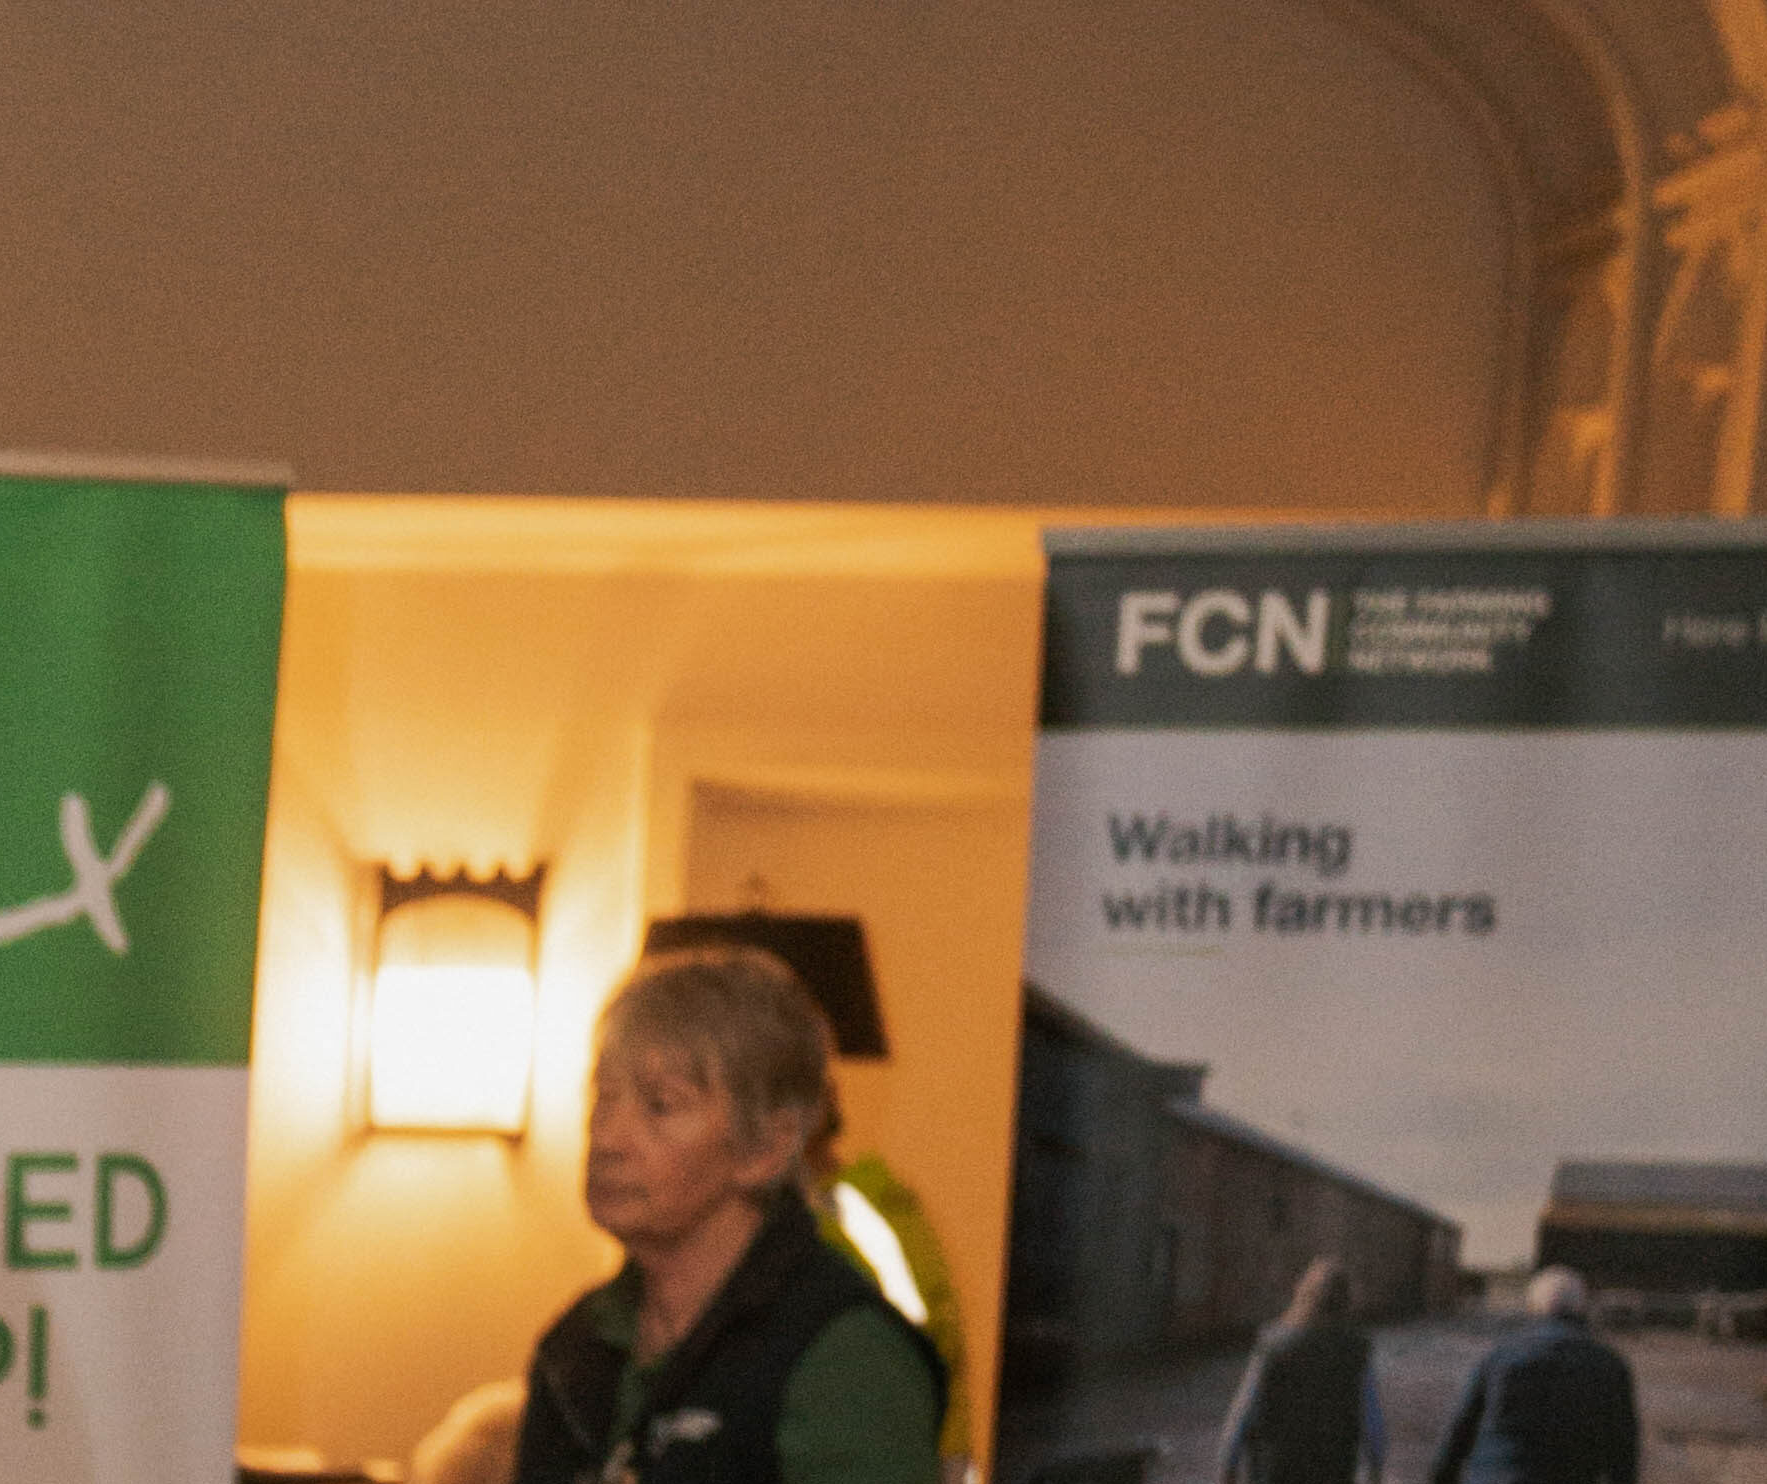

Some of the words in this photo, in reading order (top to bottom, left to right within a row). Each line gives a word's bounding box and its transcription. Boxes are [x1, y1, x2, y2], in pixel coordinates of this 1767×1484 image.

[1114, 588, 1331, 678] FCN
[1107, 811, 1352, 876] Walking
[1102, 880, 1231, 931] with
[1252, 880, 1499, 936] farmers
